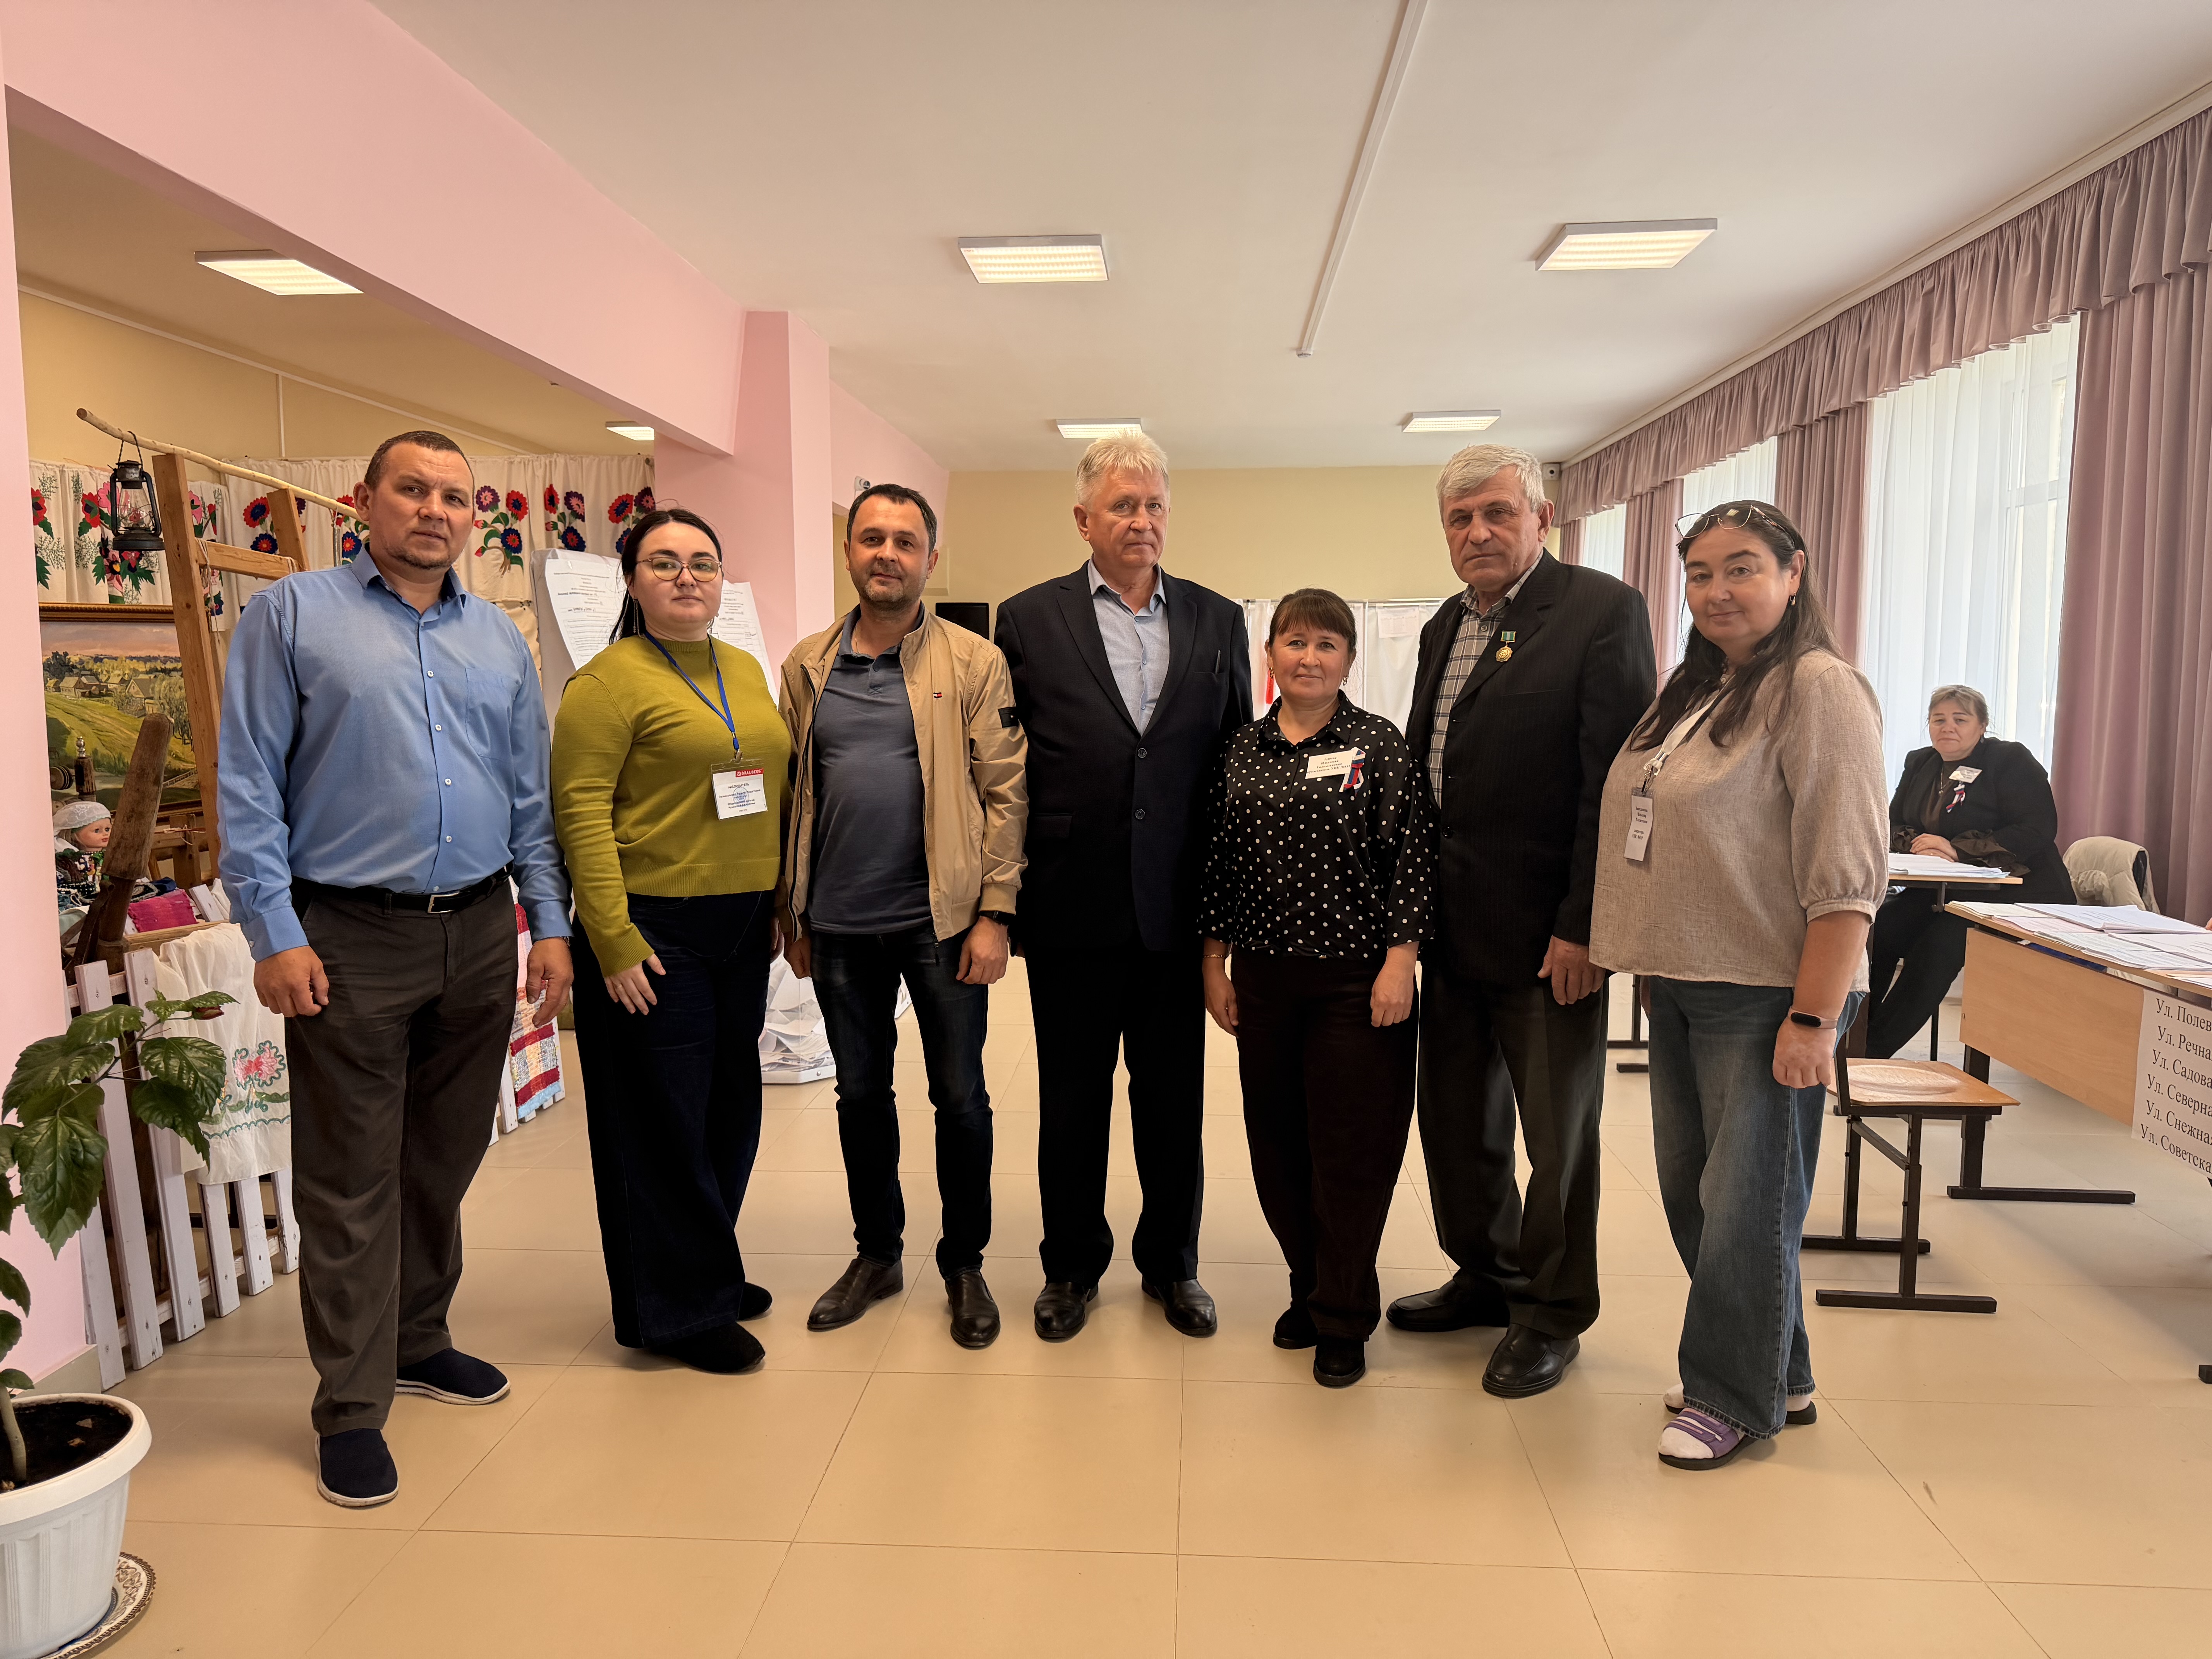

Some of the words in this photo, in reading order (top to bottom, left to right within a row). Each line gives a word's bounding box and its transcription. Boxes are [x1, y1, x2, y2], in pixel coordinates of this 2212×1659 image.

[2156, 998, 2172, 1018] Ул.
[2177, 1005, 2212, 1032] Полев
[2158, 1025, 2174, 1046] Ул.
[2178, 1034, 2212, 1061] Речна
[2153, 1049, 2168, 1070] Ул.
[2173, 1059, 2212, 1089] Садова
[2147, 1100, 2162, 1121] Ул.
[2148, 1074, 2163, 1095] Ул.
[2167, 1084, 2212, 1117] Северна
[2141, 1123, 2157, 1146] Ул.
[2161, 1135, 2212, 1174] Советска
